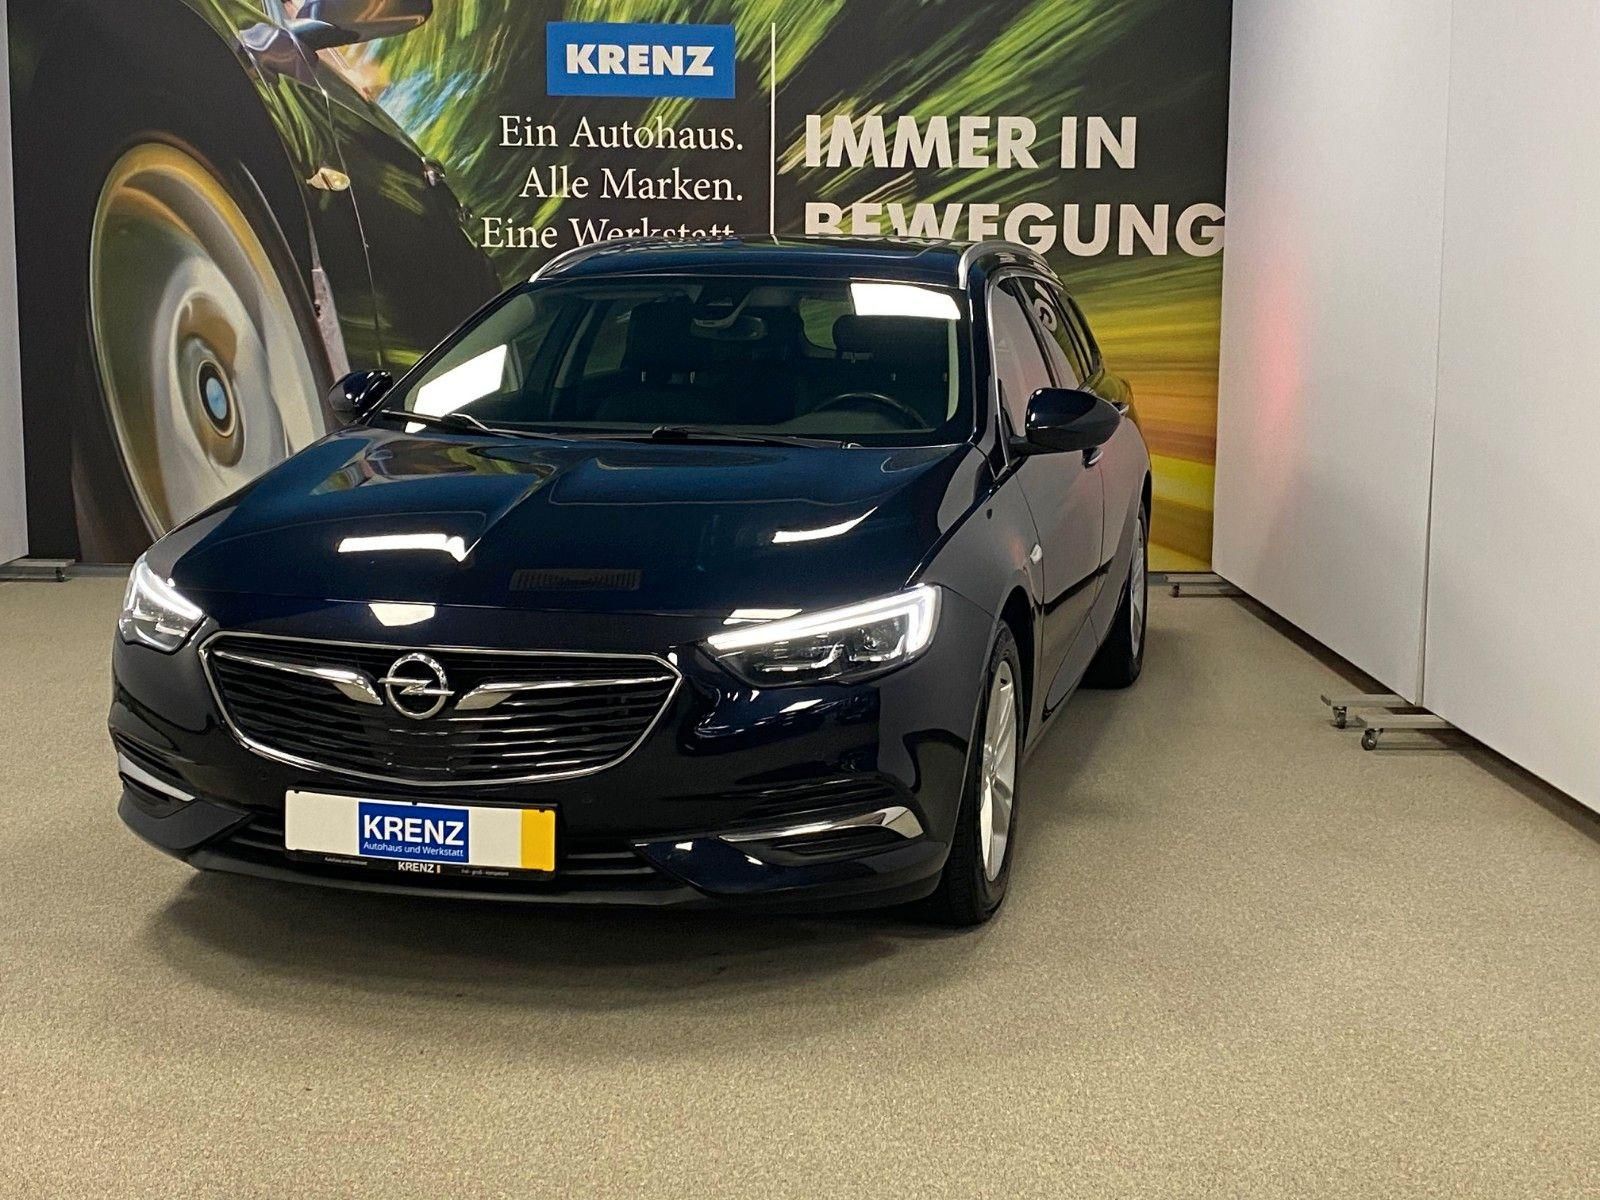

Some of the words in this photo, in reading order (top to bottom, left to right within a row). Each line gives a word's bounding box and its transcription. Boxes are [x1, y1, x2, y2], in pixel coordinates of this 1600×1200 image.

[566, 44, 714, 76] KRENZ
[499, 115, 558, 147] Ein
[569, 115, 743, 150] Autohaus.
[805, 114, 1039, 169] IMMER
[1060, 116, 1137, 169] IN
[519, 164, 589, 199] Alle
[600, 166, 743, 201] Marken.
[480, 216, 558, 249] Eine
[805, 202, 1225, 257] BEWEGUNG
[363, 814, 465, 846] KRENZ
[363, 841, 402, 853] Autohaus
[404, 845, 421, 854] und
[422, 846, 464, 857] Werkstatt
[398, 861, 435, 874] KRENZ
